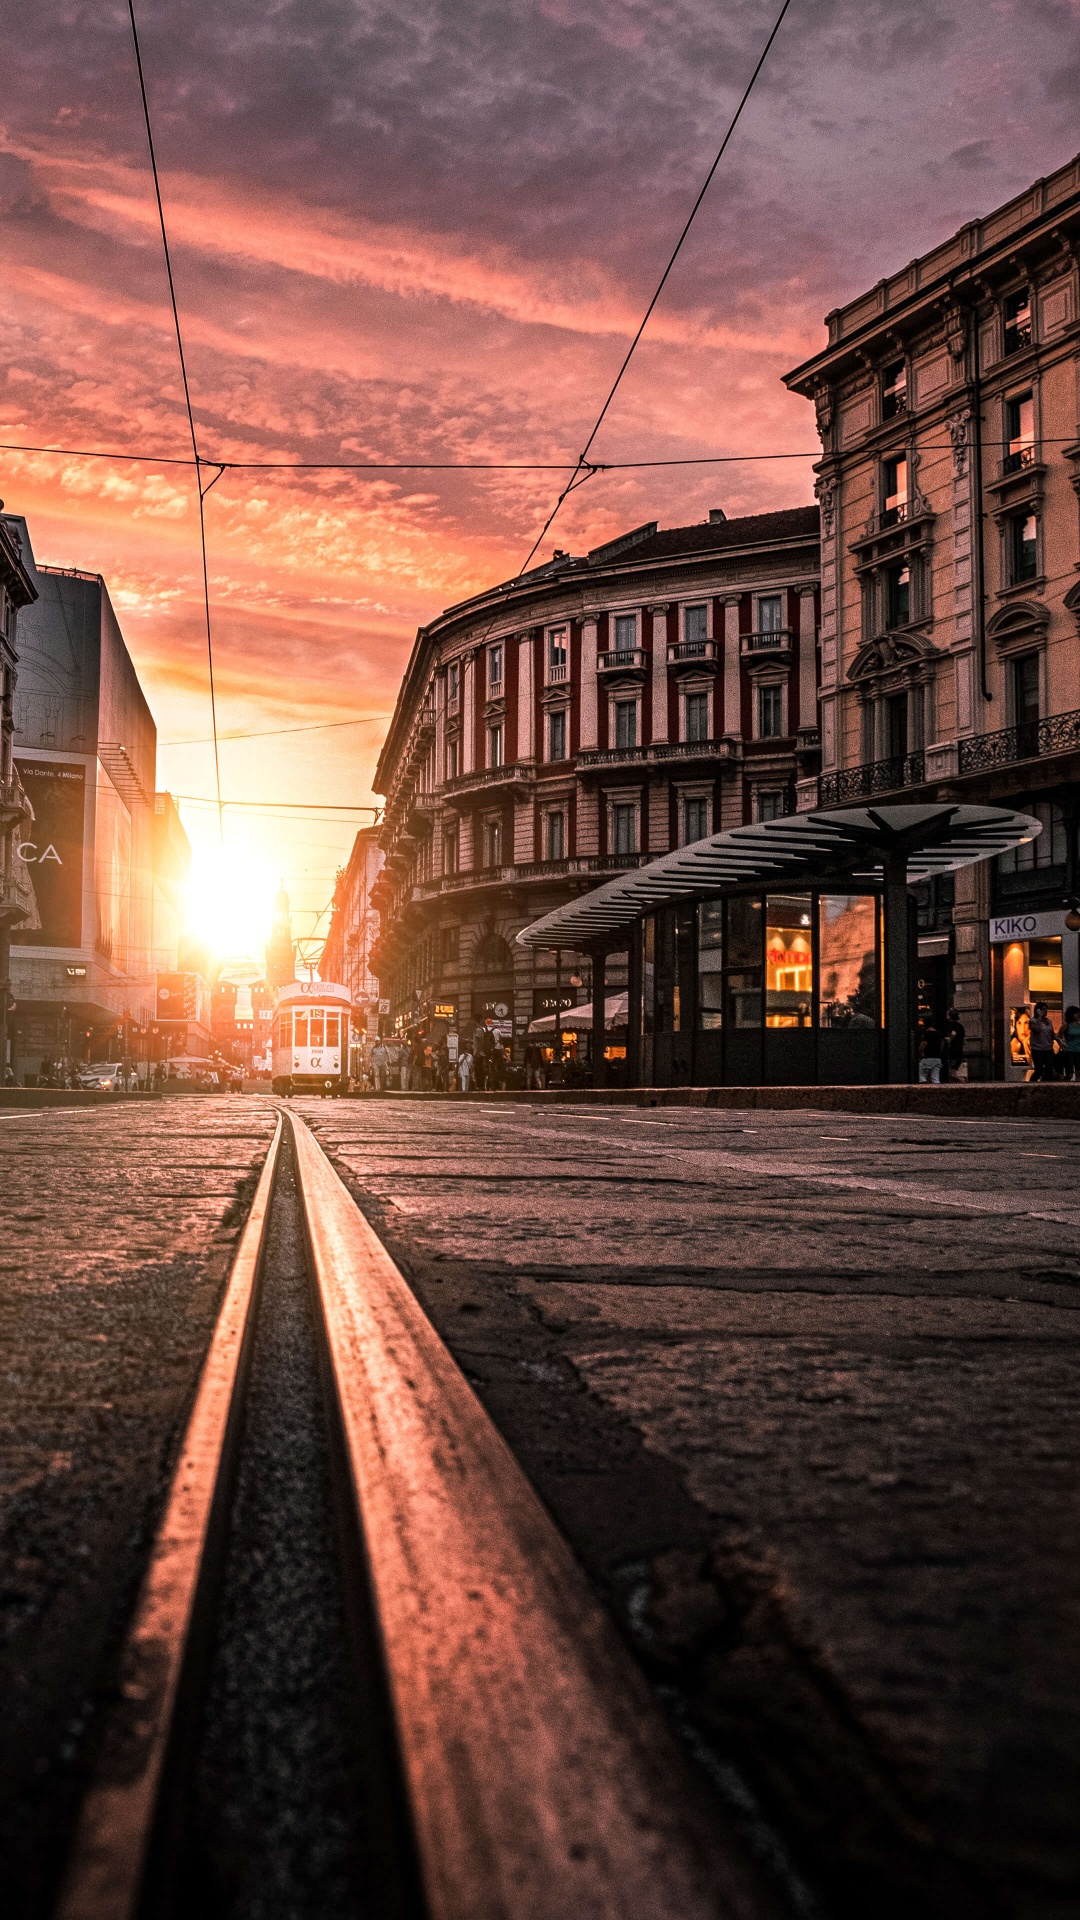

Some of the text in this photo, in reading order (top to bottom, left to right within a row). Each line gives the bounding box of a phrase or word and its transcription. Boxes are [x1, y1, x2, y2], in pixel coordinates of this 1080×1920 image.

[62, 772, 83, 780] Milano
[16, 842, 63, 865] CA
[994, 916, 1037, 935] KIKO
